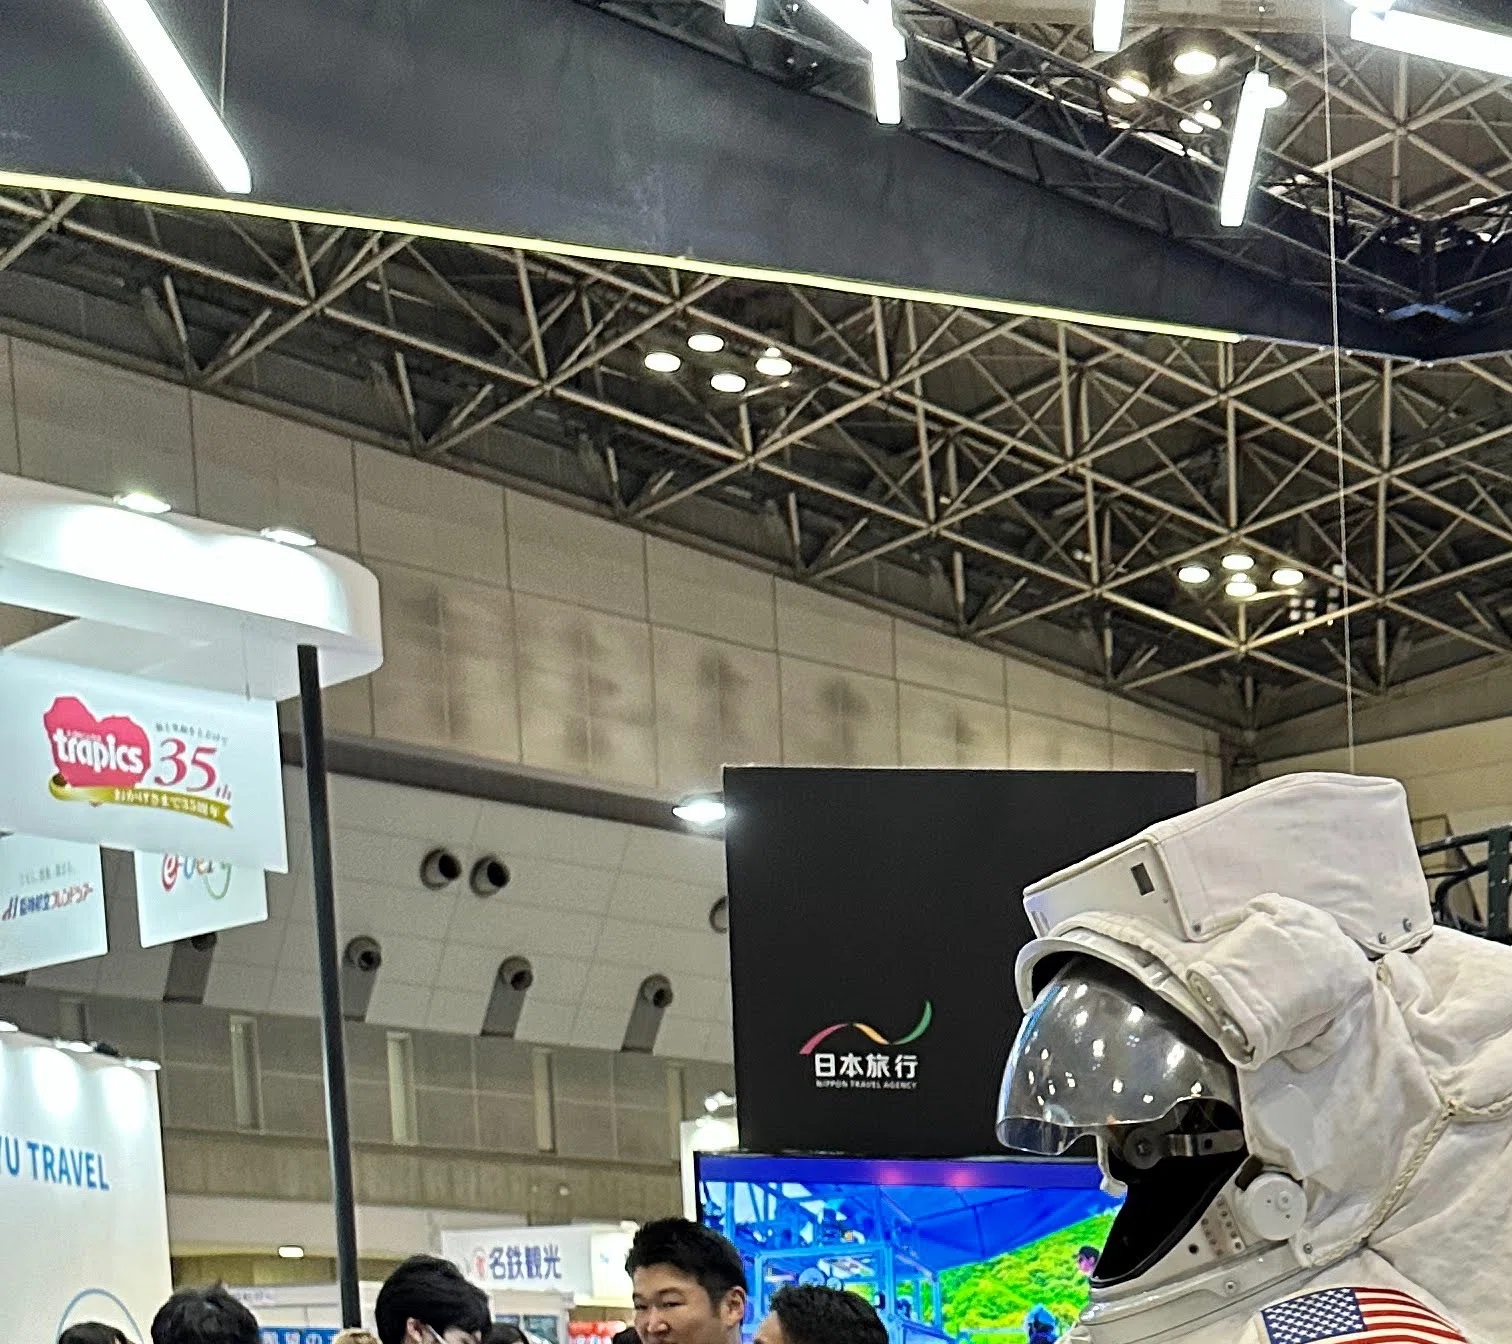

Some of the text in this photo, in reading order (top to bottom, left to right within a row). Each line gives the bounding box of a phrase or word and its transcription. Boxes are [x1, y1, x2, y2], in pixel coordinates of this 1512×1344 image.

[52, 727, 145, 774] trapics
[814, 1052, 919, 1079] 日本旅行
[815, 1079, 918, 1090] NIPPON TRAVEL AGENCY
[26, 1140, 110, 1191] TRAVEL
[488, 1244, 563, 1281] 名鉄観光
